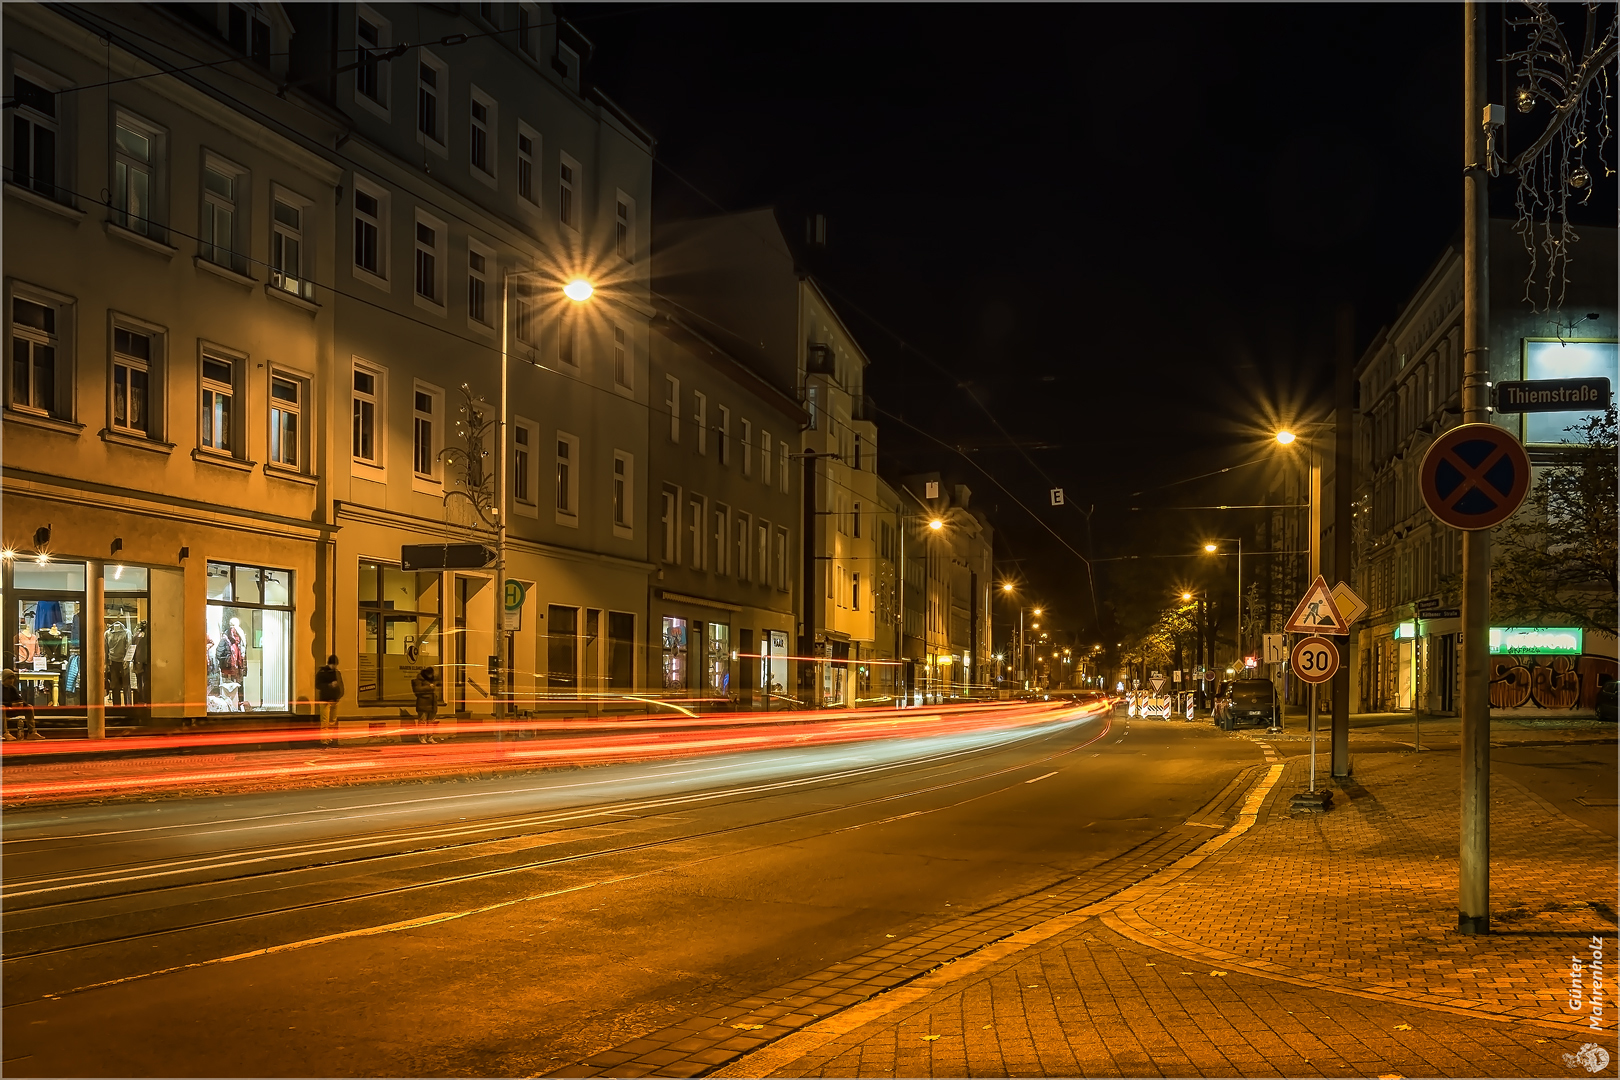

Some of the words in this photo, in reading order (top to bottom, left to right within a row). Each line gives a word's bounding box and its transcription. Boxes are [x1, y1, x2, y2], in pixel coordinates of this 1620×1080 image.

[1508, 385, 1598, 404] Thiemstraße
[1054, 491, 1061, 503] E
[505, 586, 517, 604] H
[1302, 650, 1328, 671] 30
